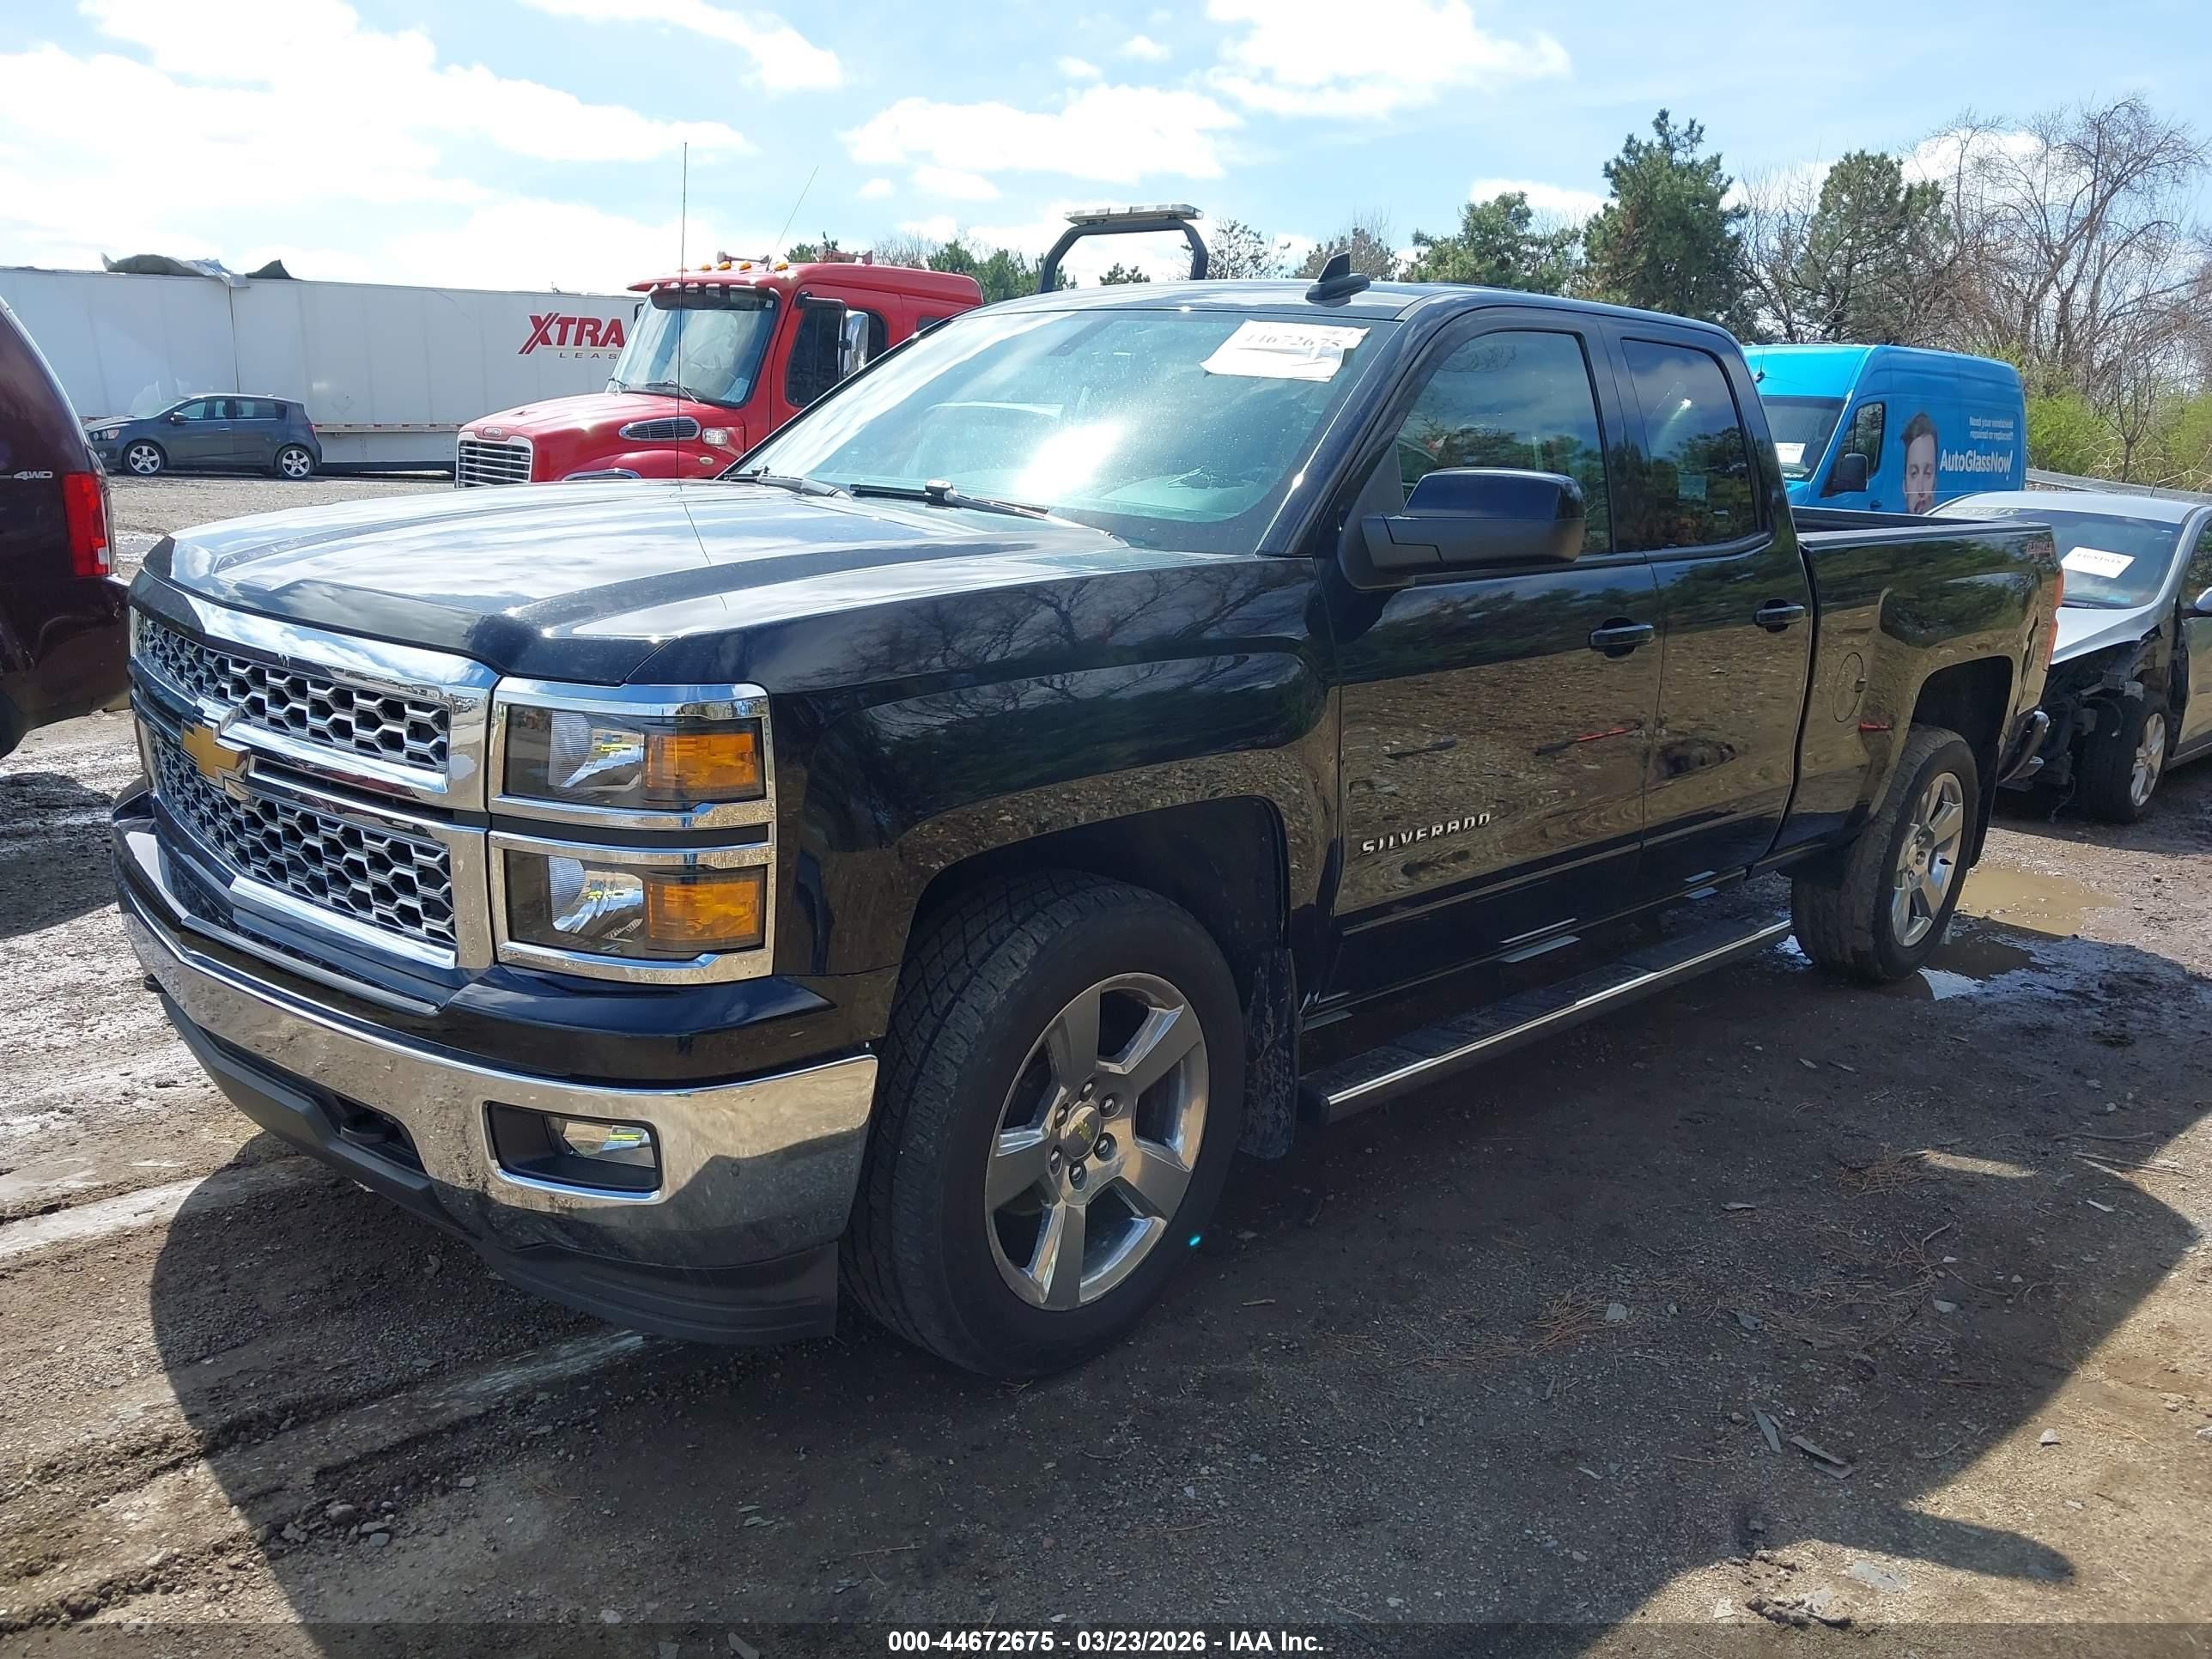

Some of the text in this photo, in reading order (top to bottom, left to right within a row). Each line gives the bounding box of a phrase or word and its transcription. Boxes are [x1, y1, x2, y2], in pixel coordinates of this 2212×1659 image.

[518, 313, 626, 354] XTRA
[13, 471, 53, 481] 4WD
[1360, 811, 1492, 856] SILVERADO
